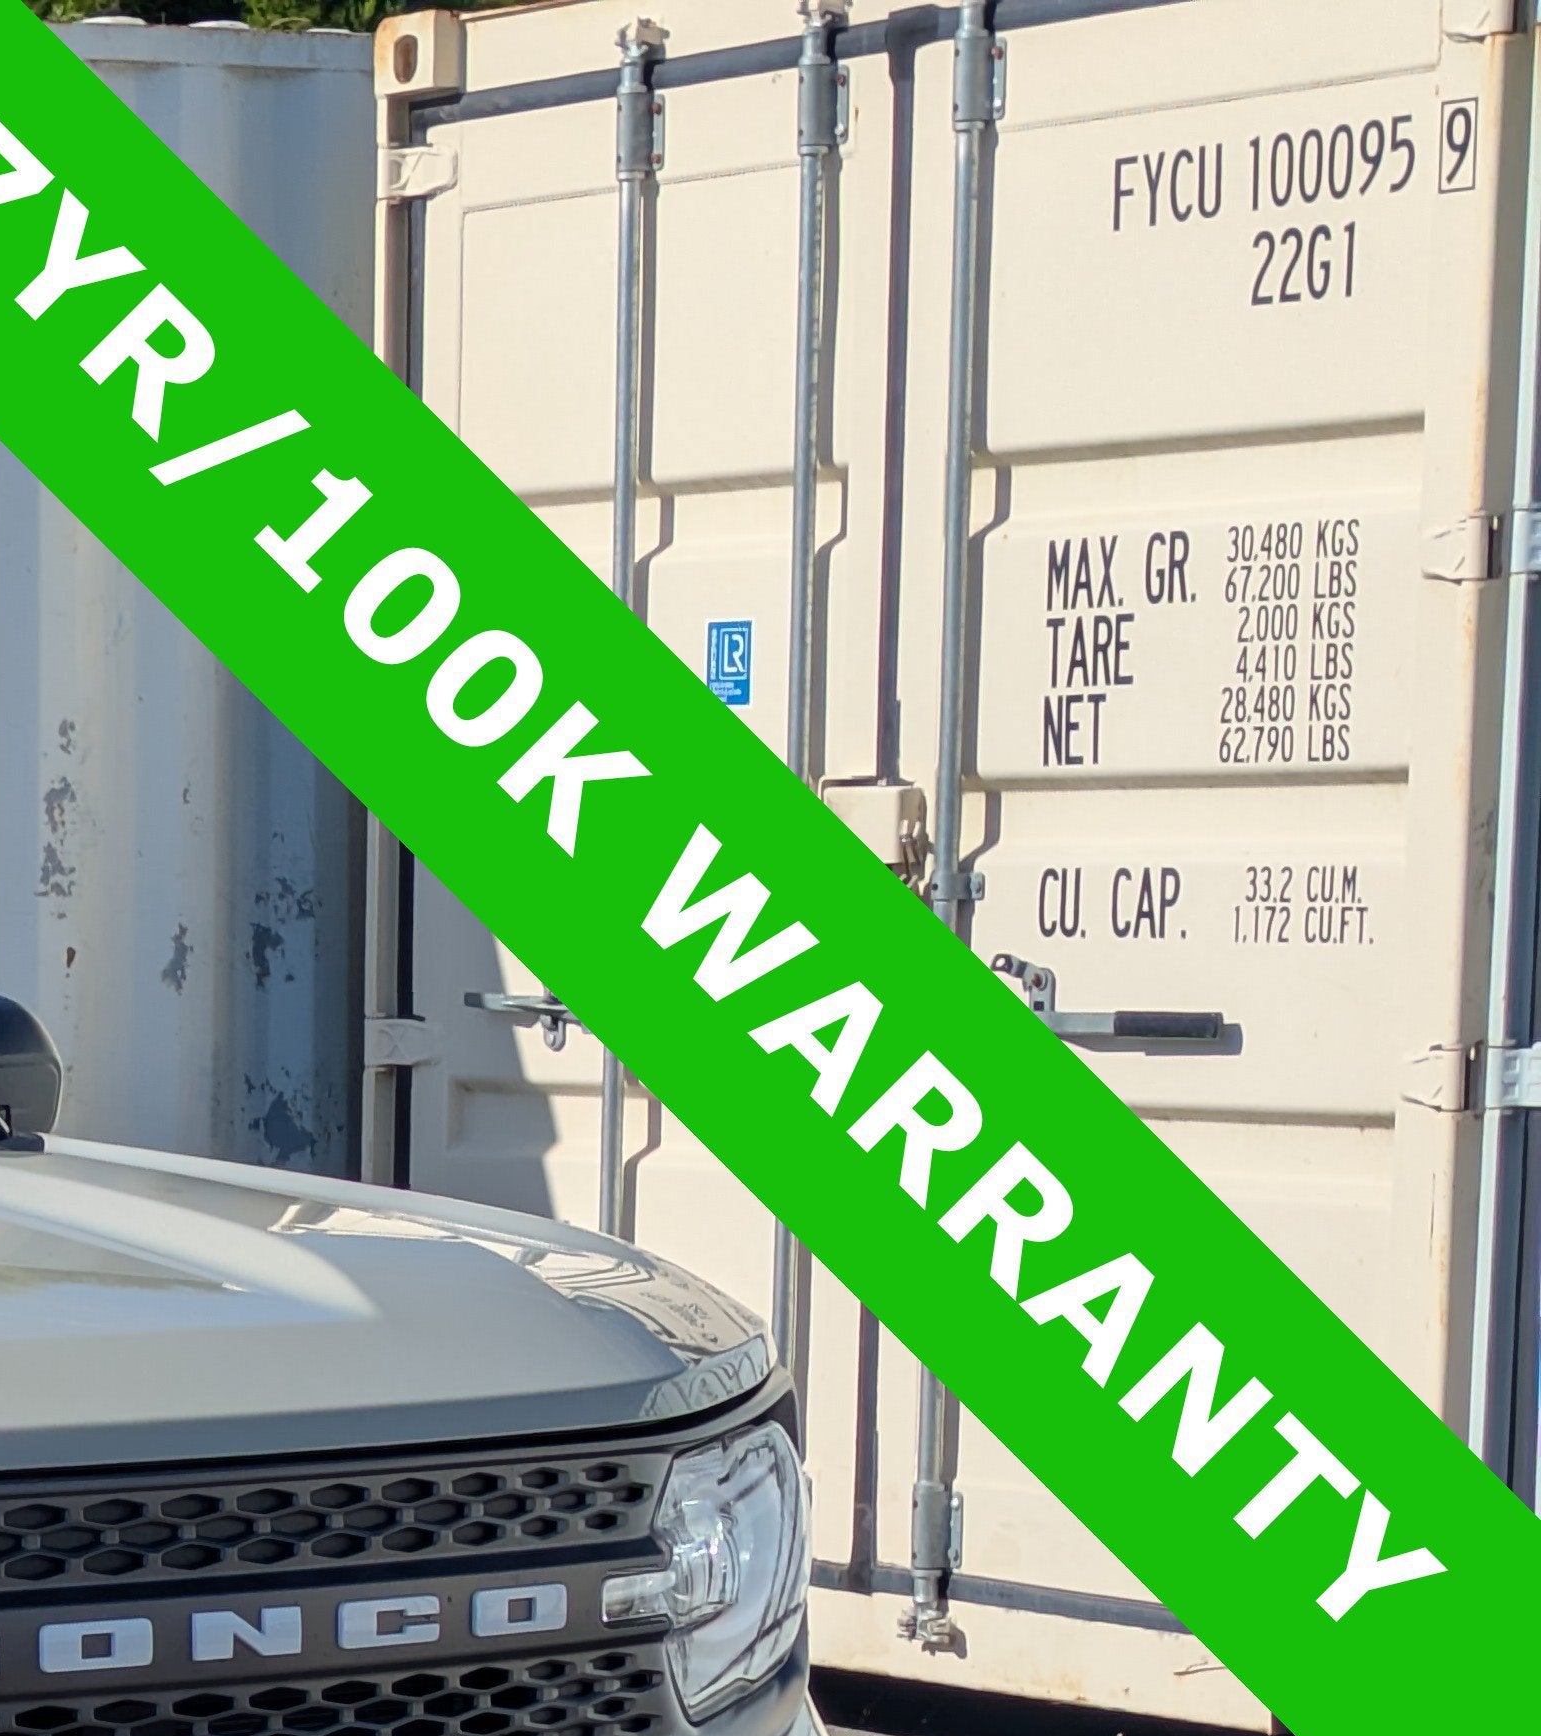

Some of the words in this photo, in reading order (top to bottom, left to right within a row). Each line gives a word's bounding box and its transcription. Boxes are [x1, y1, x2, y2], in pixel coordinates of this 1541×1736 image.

[1113, 143, 1223, 232] FYCU
[1249, 114, 1416, 212] 100095
[1443, 104, 1474, 186] 9
[1251, 221, 1356, 306] 22G1
[1315, 518, 1360, 559] KGS
[1046, 535, 1124, 612] MAX.
[1145, 530, 1197, 605] GR.
[1313, 559, 1357, 600] LBS
[1311, 600, 1356, 641] KGS
[1046, 612, 1135, 689] TARE
[1310, 641, 1354, 681] LBS
[1308, 682, 1352, 722] KGS
[1042, 693, 1107, 767] NET
[1307, 723, 1350, 763] LBS
[1038, 867, 1087, 939] CU.
[1111, 866, 1187, 940] CAP.
[1245, 865, 1293, 904] 33.2
